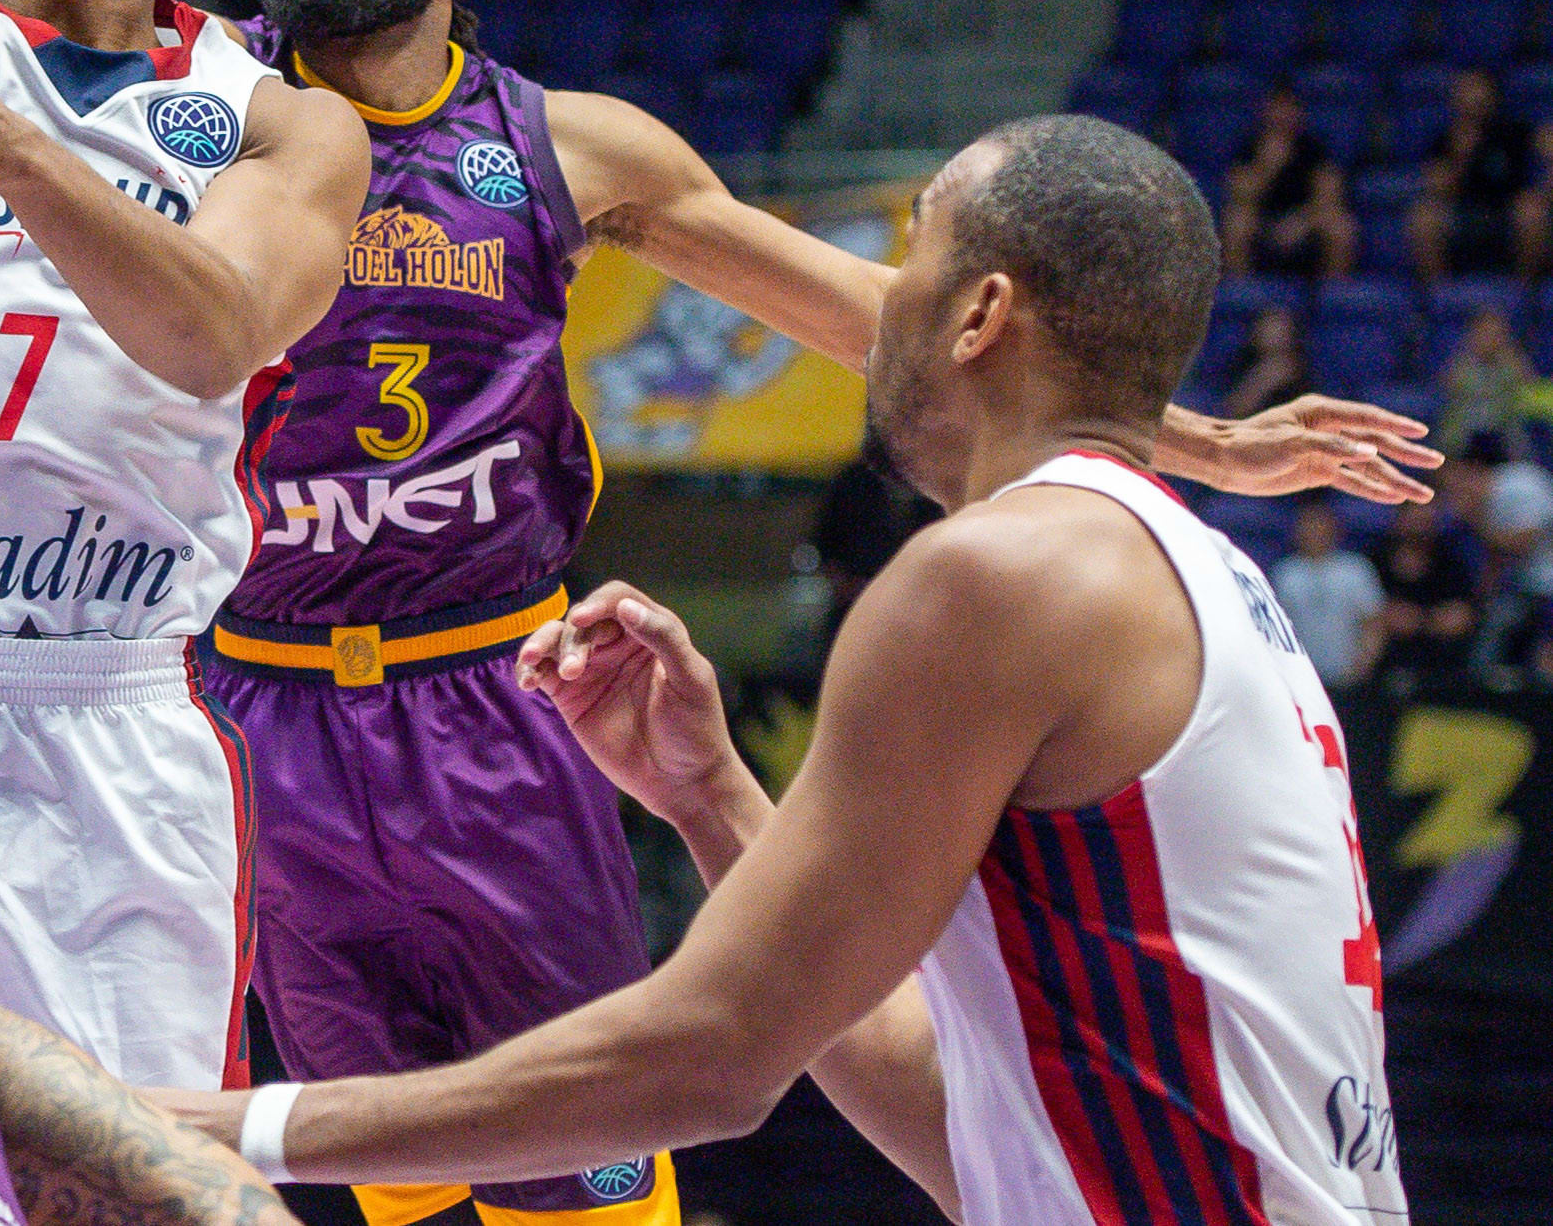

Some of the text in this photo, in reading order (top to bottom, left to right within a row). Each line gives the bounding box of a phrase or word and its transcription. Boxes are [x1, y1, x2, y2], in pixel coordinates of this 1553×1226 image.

[343, 237, 505, 301] OEL HOLON
[355, 342, 431, 462] 3
